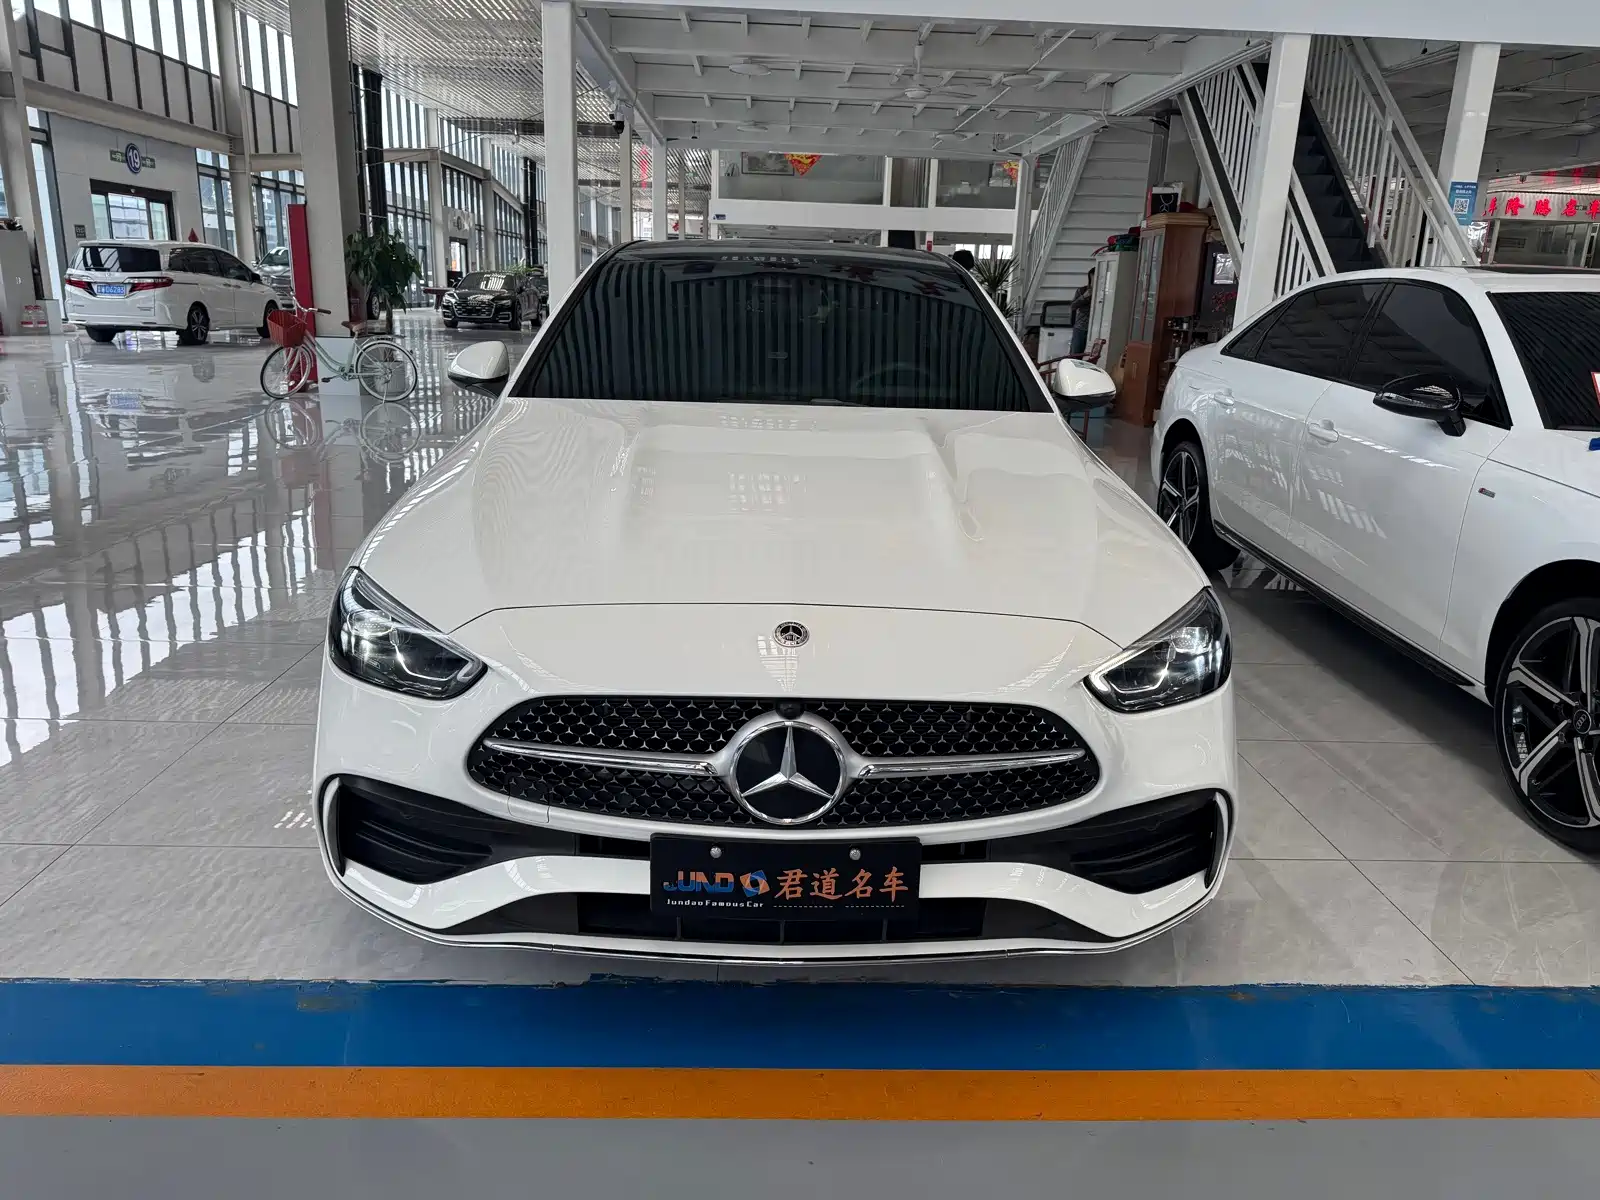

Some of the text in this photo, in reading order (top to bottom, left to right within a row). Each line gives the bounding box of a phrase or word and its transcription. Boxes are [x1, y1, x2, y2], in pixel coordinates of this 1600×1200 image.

[128, 149, 140, 169] 19
[774, 866, 909, 903] 君道名车
